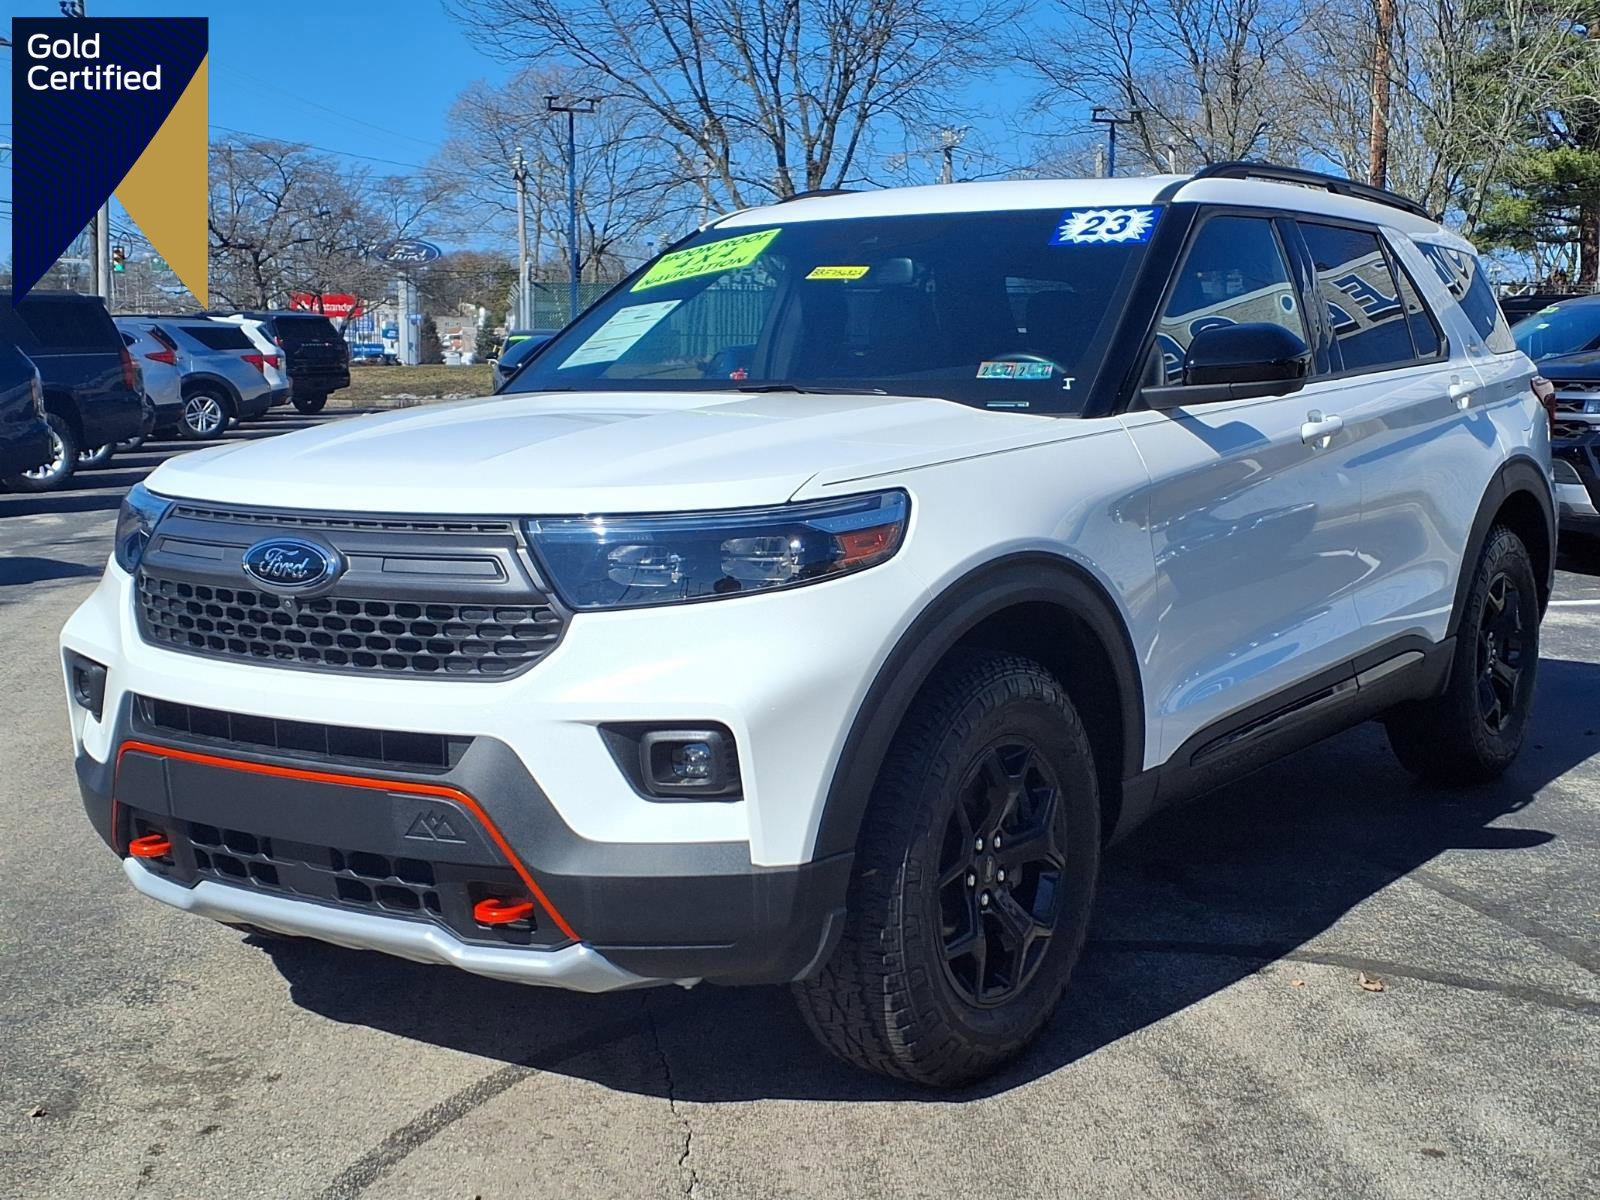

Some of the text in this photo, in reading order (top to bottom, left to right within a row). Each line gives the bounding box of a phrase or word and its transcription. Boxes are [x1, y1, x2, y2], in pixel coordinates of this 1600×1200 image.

[1078, 215, 1132, 236] 23
[718, 231, 774, 249] ROOF
[387, 244, 426, 261] Ford
[638, 254, 749, 286] NAVIGATION
[259, 547, 310, 578] Ford
